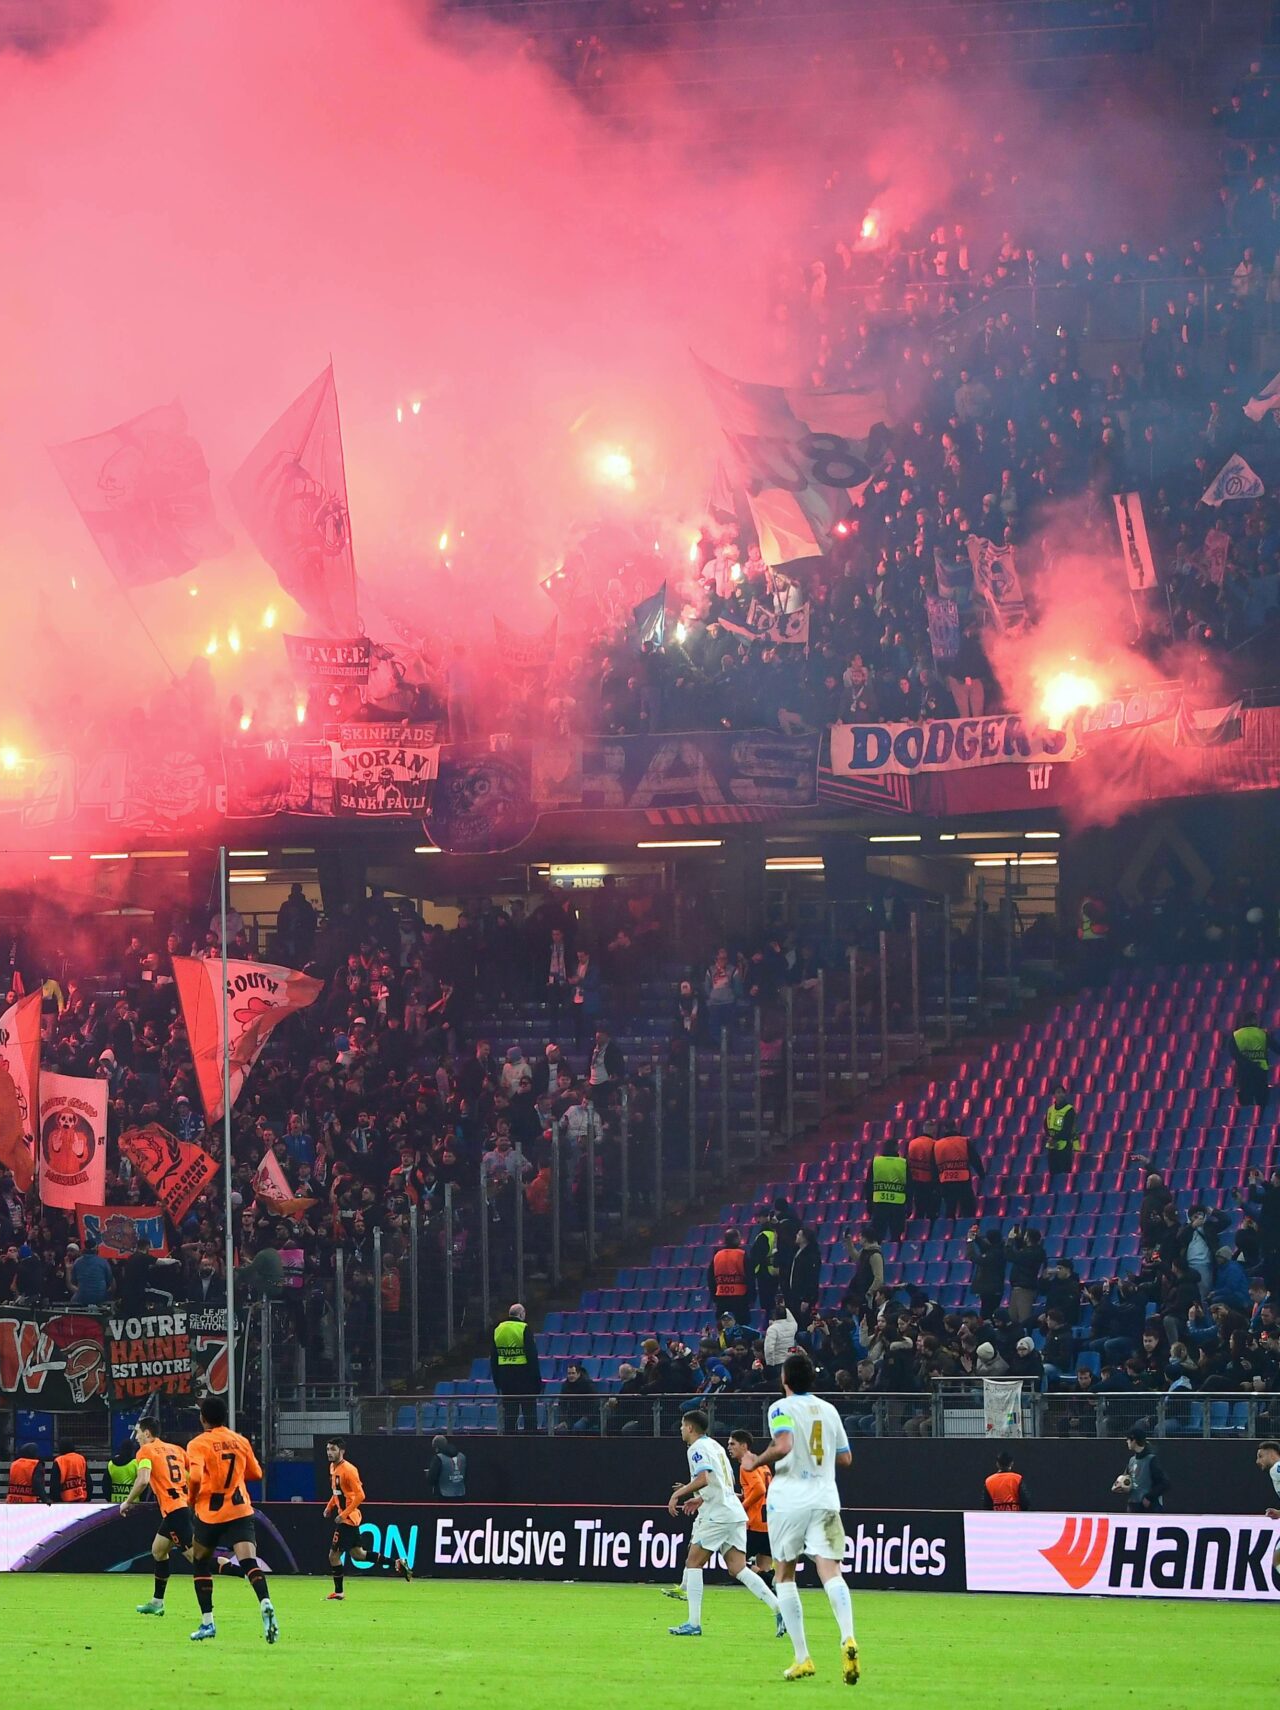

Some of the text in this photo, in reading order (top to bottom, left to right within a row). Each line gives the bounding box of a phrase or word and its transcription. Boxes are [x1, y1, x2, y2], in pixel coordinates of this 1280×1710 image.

[341, 727, 434, 742] SKINHEADS
[341, 794, 385, 810] SANKT
[226, 972, 278, 1001] SOUTH
[880, 1192, 896, 1201] 315
[108, 1312, 187, 1340] VOTRE
[110, 1335, 191, 1364] HAINE
[111, 1358, 191, 1378] EST NOTRE
[809, 1420, 824, 1466] 4
[166, 1454, 182, 1483] 6
[221, 1453, 236, 1489] 7
[340, 1523, 418, 1569] ON
[435, 1517, 566, 1566] Exclusive
[574, 1519, 631, 1568] Tire
[638, 1519, 684, 1569] for
[841, 1523, 945, 1576] ehicles
